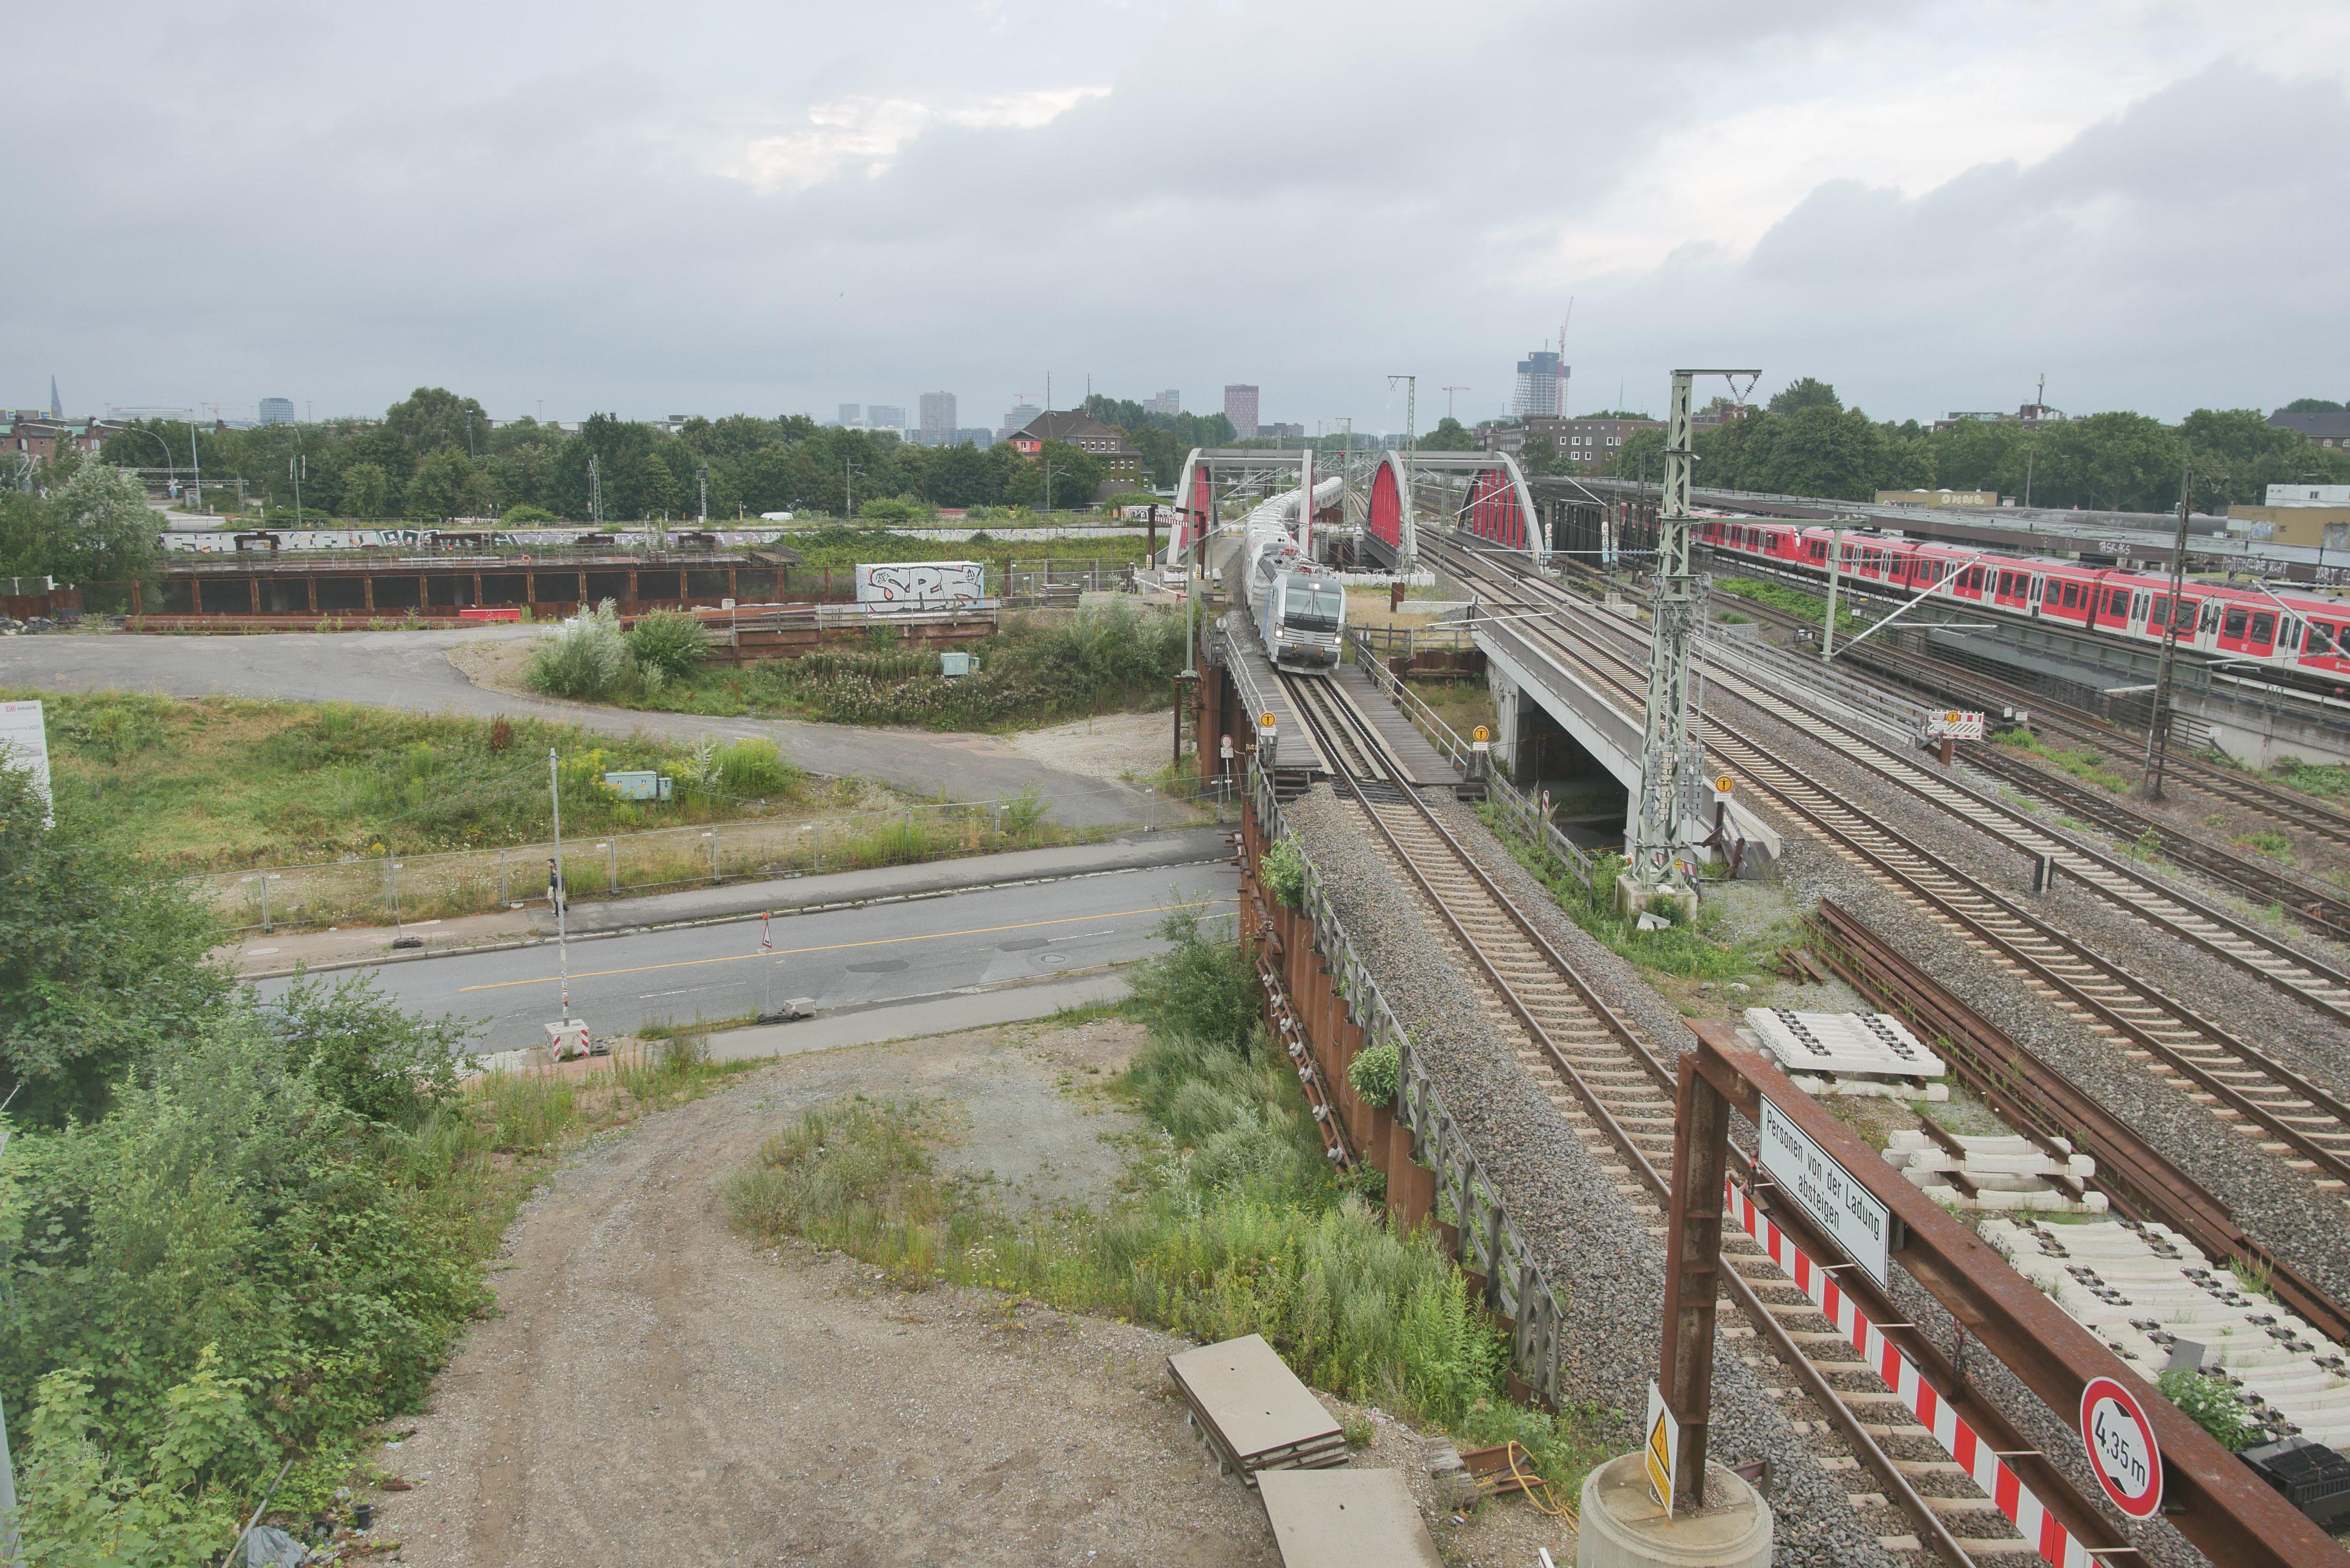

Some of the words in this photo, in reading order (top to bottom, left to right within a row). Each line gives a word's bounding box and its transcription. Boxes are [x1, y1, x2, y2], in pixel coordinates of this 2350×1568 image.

[1767, 1109, 1802, 1163] Personen
[1808, 1152, 1822, 1181] von
[1827, 1168, 1841, 1199] der
[1846, 1183, 1880, 1241] Ladung
[1798, 1174, 1839, 1230] absteigen
